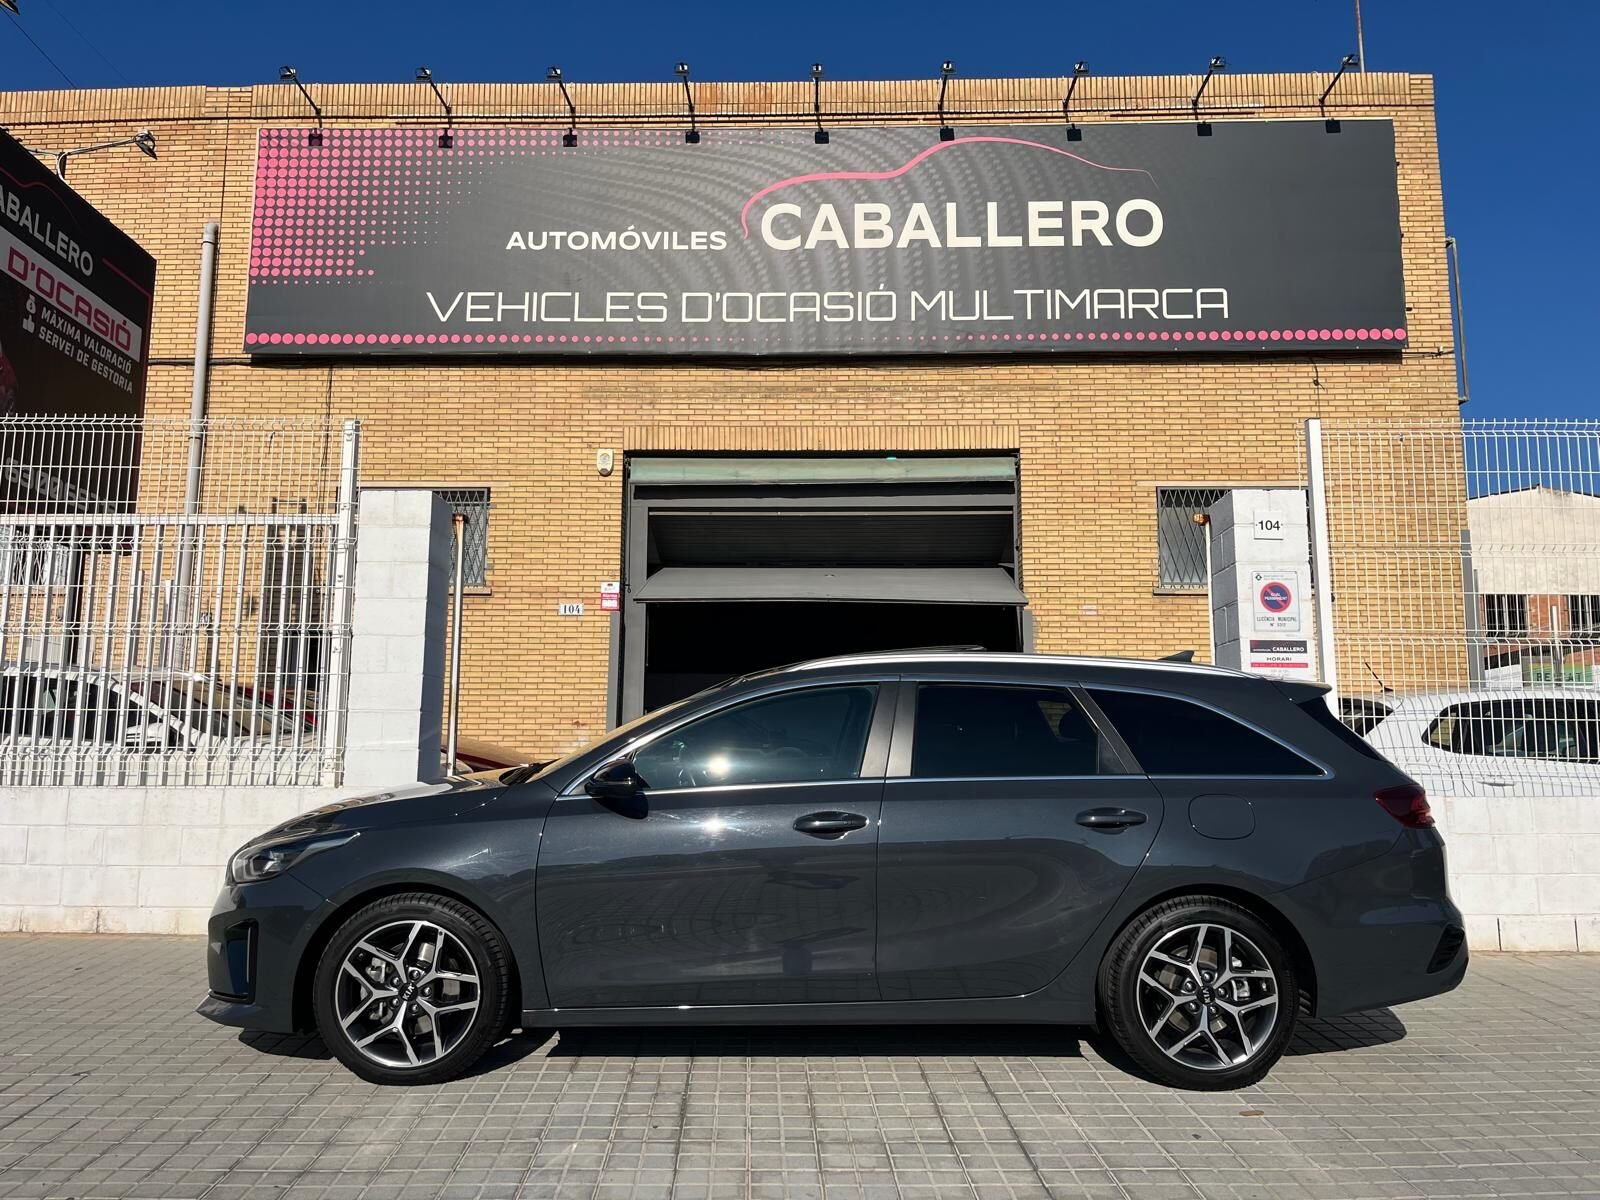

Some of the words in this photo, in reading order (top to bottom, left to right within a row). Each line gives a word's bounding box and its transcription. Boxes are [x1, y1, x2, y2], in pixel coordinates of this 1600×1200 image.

[505, 225, 727, 251] AUTOMÓVILES
[760, 198, 1165, 251] CABALLERO
[7, 245, 132, 353] D'OCASIÓ
[426, 291, 668, 323] VEHICLES
[681, 283, 897, 323] D'OCASIÓ
[911, 288, 1229, 321] MULTIMARCA
[38, 325, 75, 358] SERVEI
[76, 349, 90, 367] DE
[90, 358, 134, 394] GESTORIA
[1258, 519, 1281, 531] 104
[563, 604, 580, 614] 104
